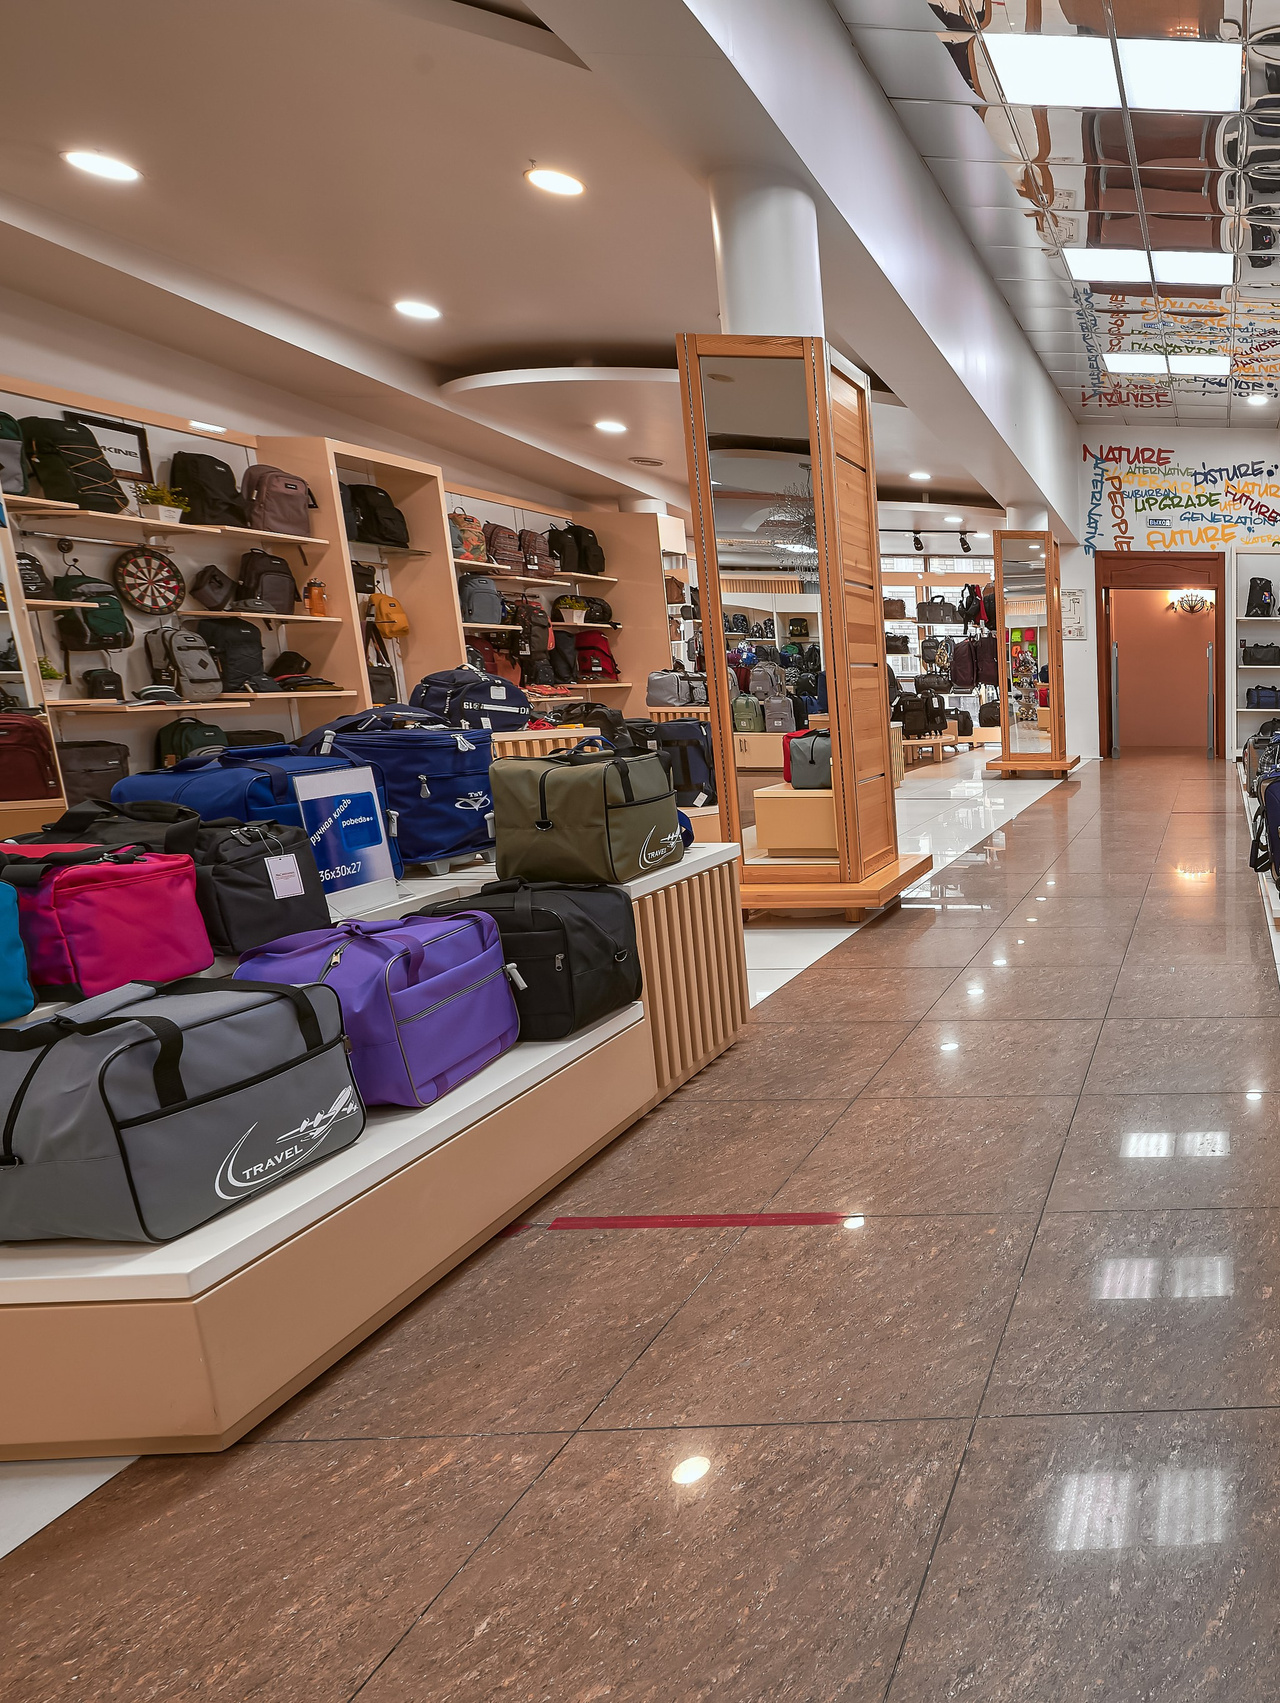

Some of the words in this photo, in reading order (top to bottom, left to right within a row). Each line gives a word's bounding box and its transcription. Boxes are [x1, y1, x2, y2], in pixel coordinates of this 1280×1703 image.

[1082, 443, 1175, 466] NATURE
[1126, 463, 1195, 477] ALTERNATIVE
[1191, 461, 1265, 486] DISTURE
[1121, 486, 1177, 500] SUBURBAN
[1135, 492, 1222, 513] UPGRADE
[1225, 485, 1280, 523] FUTURE
[1105, 475, 1135, 551] PEOPLE
[1179, 511, 1276, 527] GENERATION
[1146, 523, 1239, 550] FUTURE
[309, 817, 334, 847] ручная
[332, 798, 352, 819] кладь
[341, 815, 366, 828] pobeda
[647, 847, 667, 860] TRAVEL
[318, 861, 362, 883] 36x30x27
[241, 1144, 304, 1181] TRAVEL
